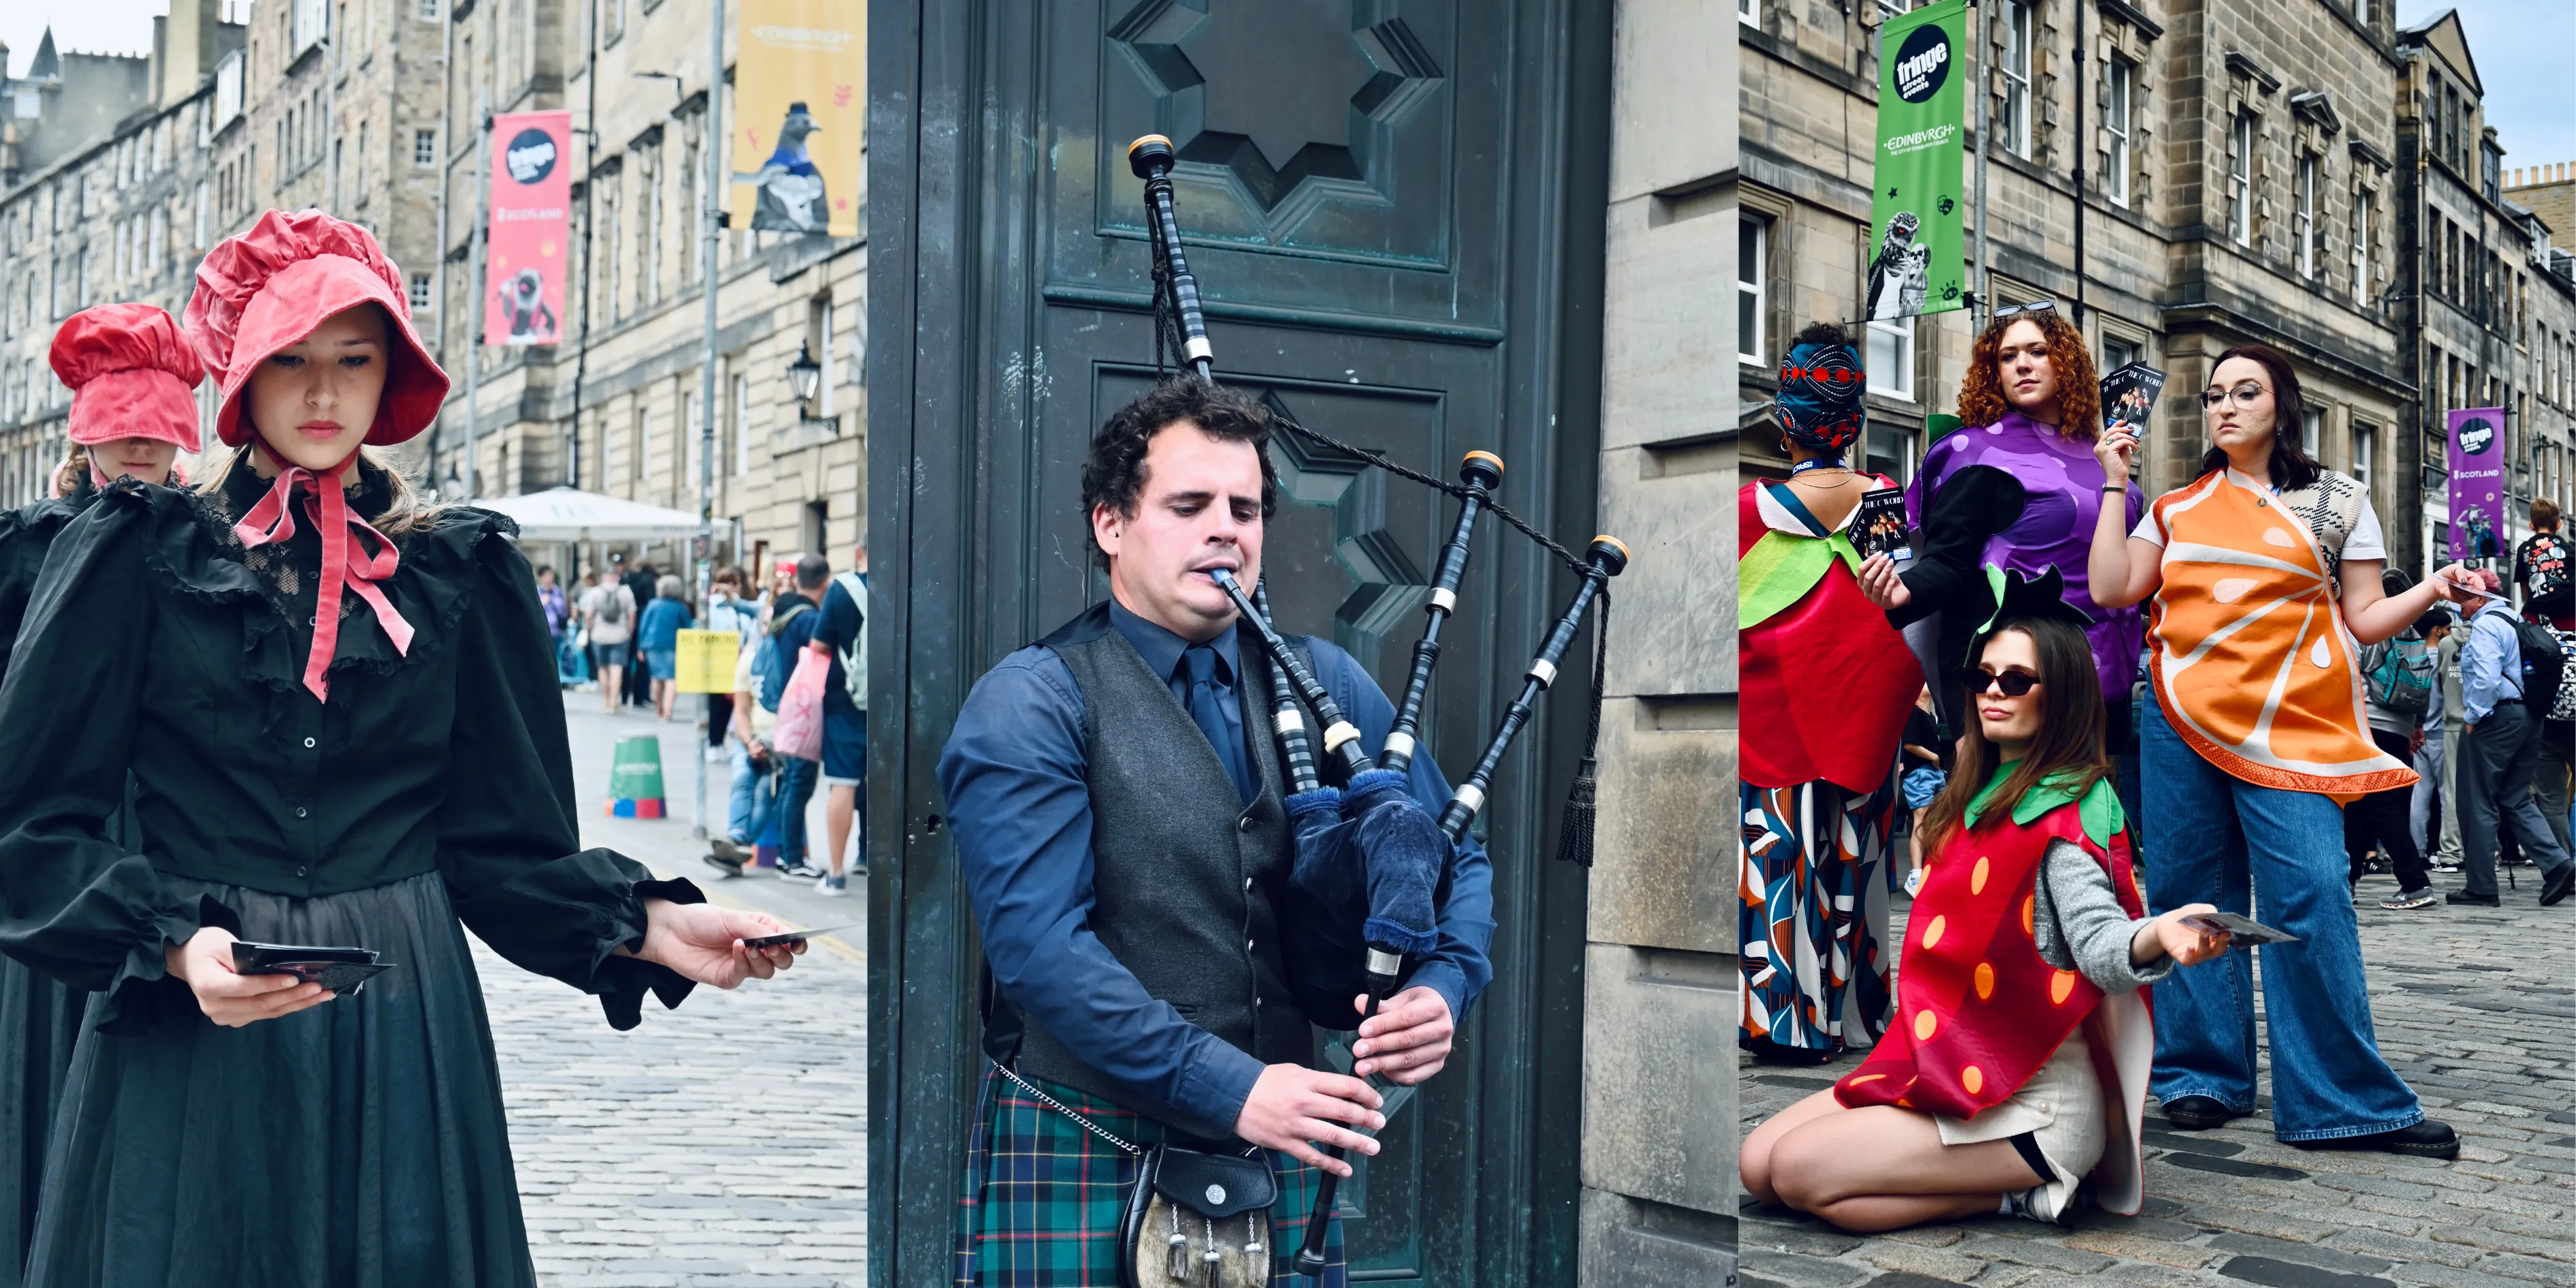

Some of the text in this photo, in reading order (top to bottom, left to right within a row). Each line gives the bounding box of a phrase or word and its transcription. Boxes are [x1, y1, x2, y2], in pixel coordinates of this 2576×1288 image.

[1897, 42, 1947, 85] fringe
[1903, 74, 1925, 92] street
[1903, 81, 1929, 99] events
[1887, 123, 1952, 150] EDINBVRGH
[2145, 375, 2162, 387] WORD
[2459, 427, 2492, 446] fringe
[2459, 470, 2499, 478] SCOTLAND
[1883, 497, 1903, 505] WORD
